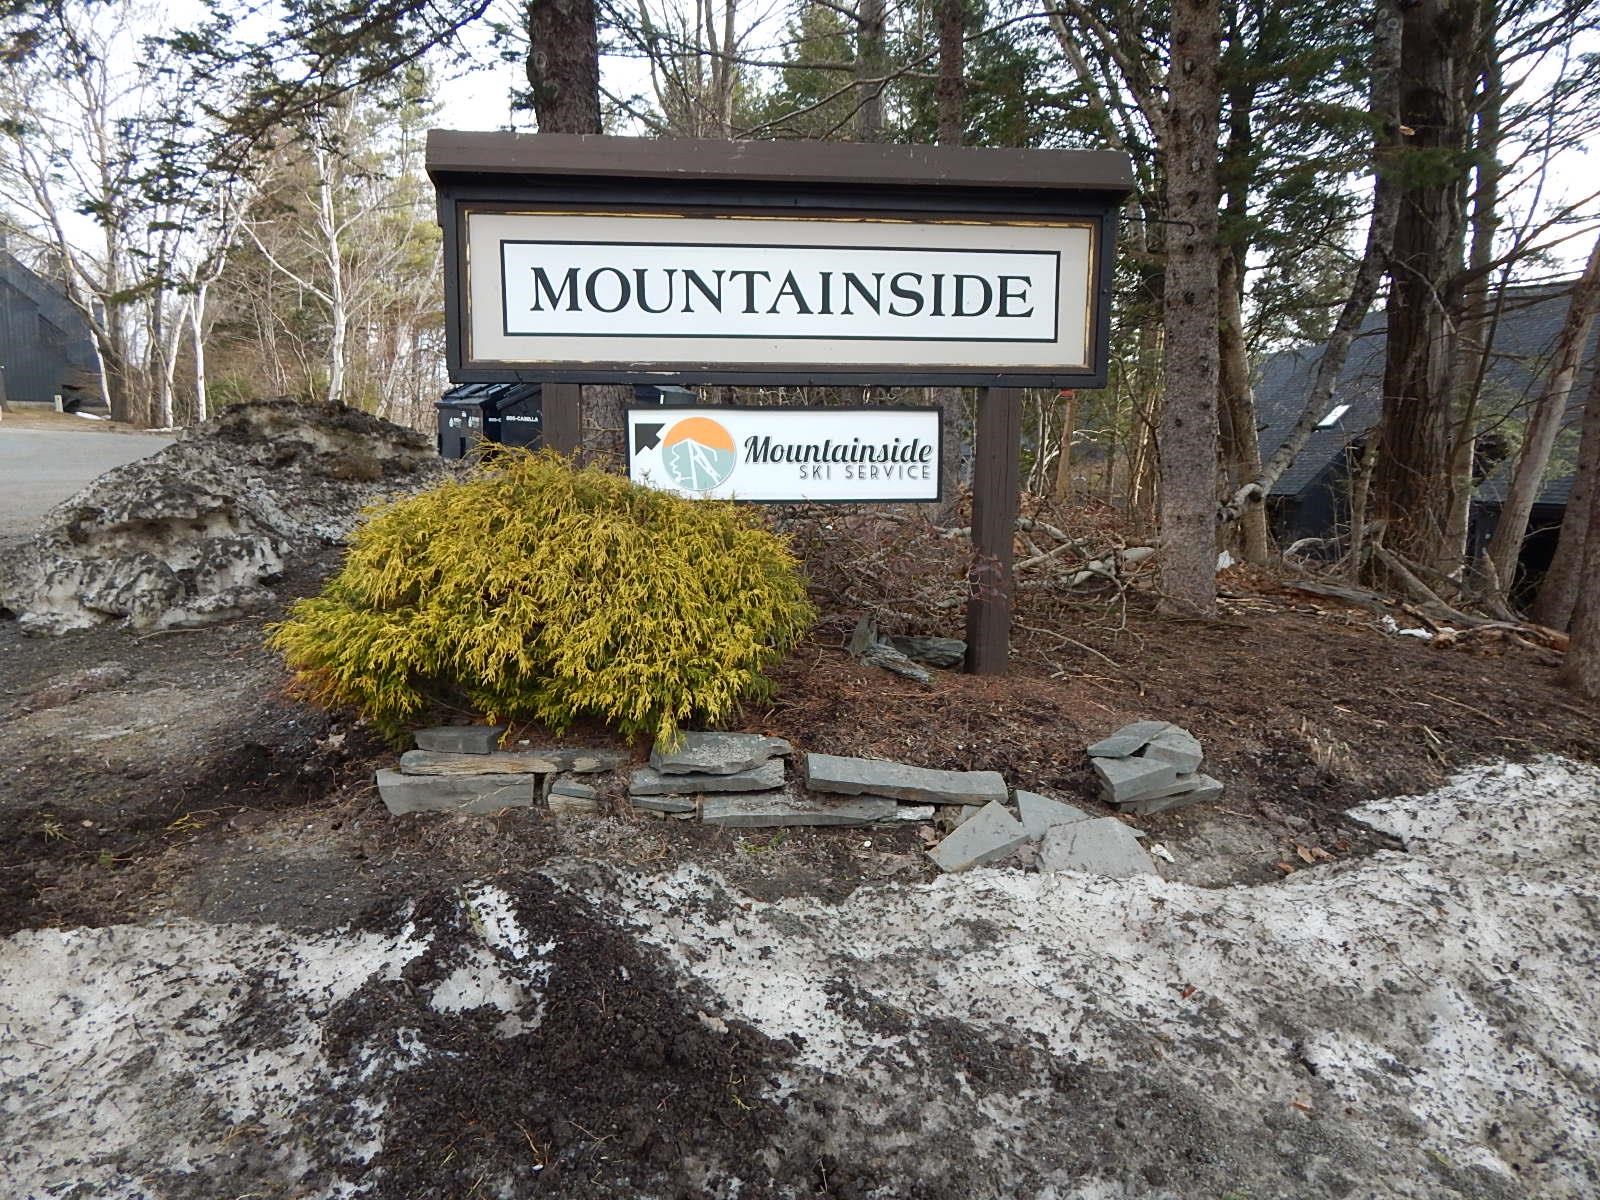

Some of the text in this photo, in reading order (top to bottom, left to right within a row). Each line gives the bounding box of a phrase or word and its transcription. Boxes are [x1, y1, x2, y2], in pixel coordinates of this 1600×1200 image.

[529, 266, 1035, 318] MOUNTAINSIDE
[744, 435, 932, 464] Mountainside
[799, 465, 931, 480] SKI SERVICE
